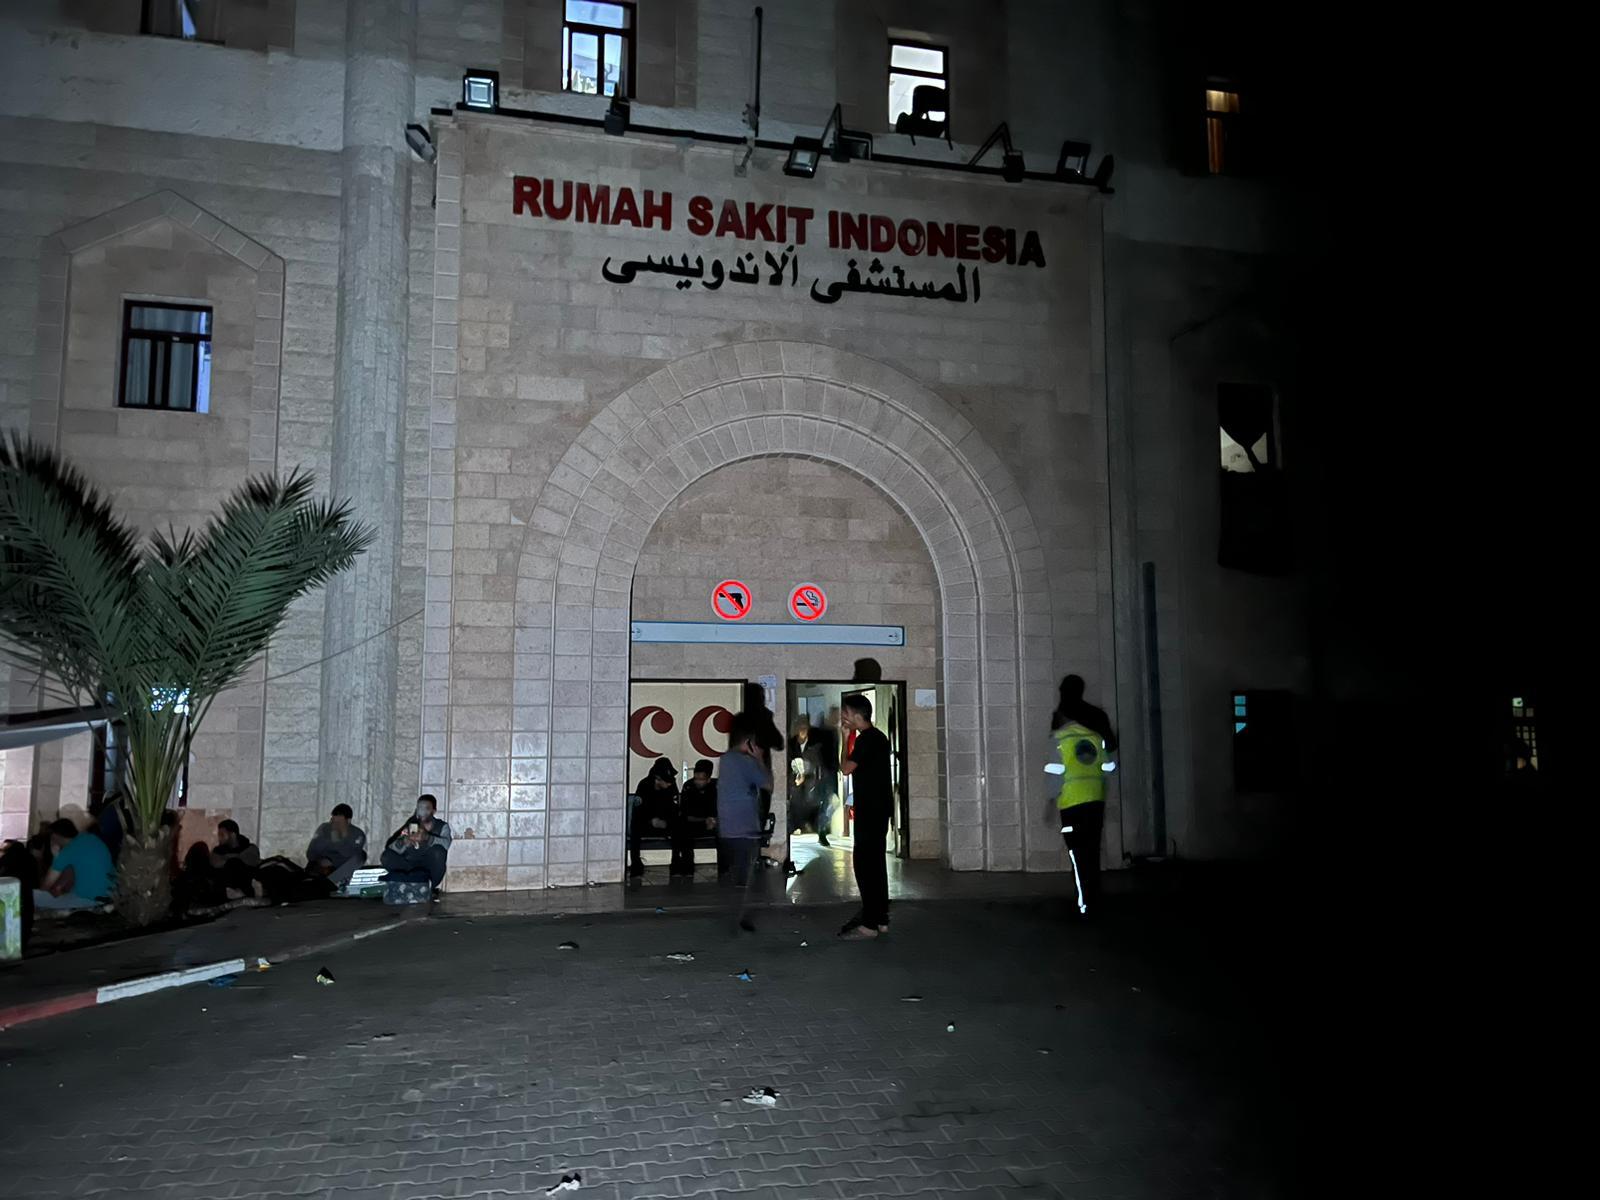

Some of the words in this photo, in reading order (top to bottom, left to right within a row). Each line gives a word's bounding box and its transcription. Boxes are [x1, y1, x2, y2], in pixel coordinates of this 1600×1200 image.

[513, 175, 672, 231] RUMAH
[687, 196, 814, 245] SAKIT
[828, 210, 1046, 268] INDONESIA
[810, 258, 980, 304] المستشفى
